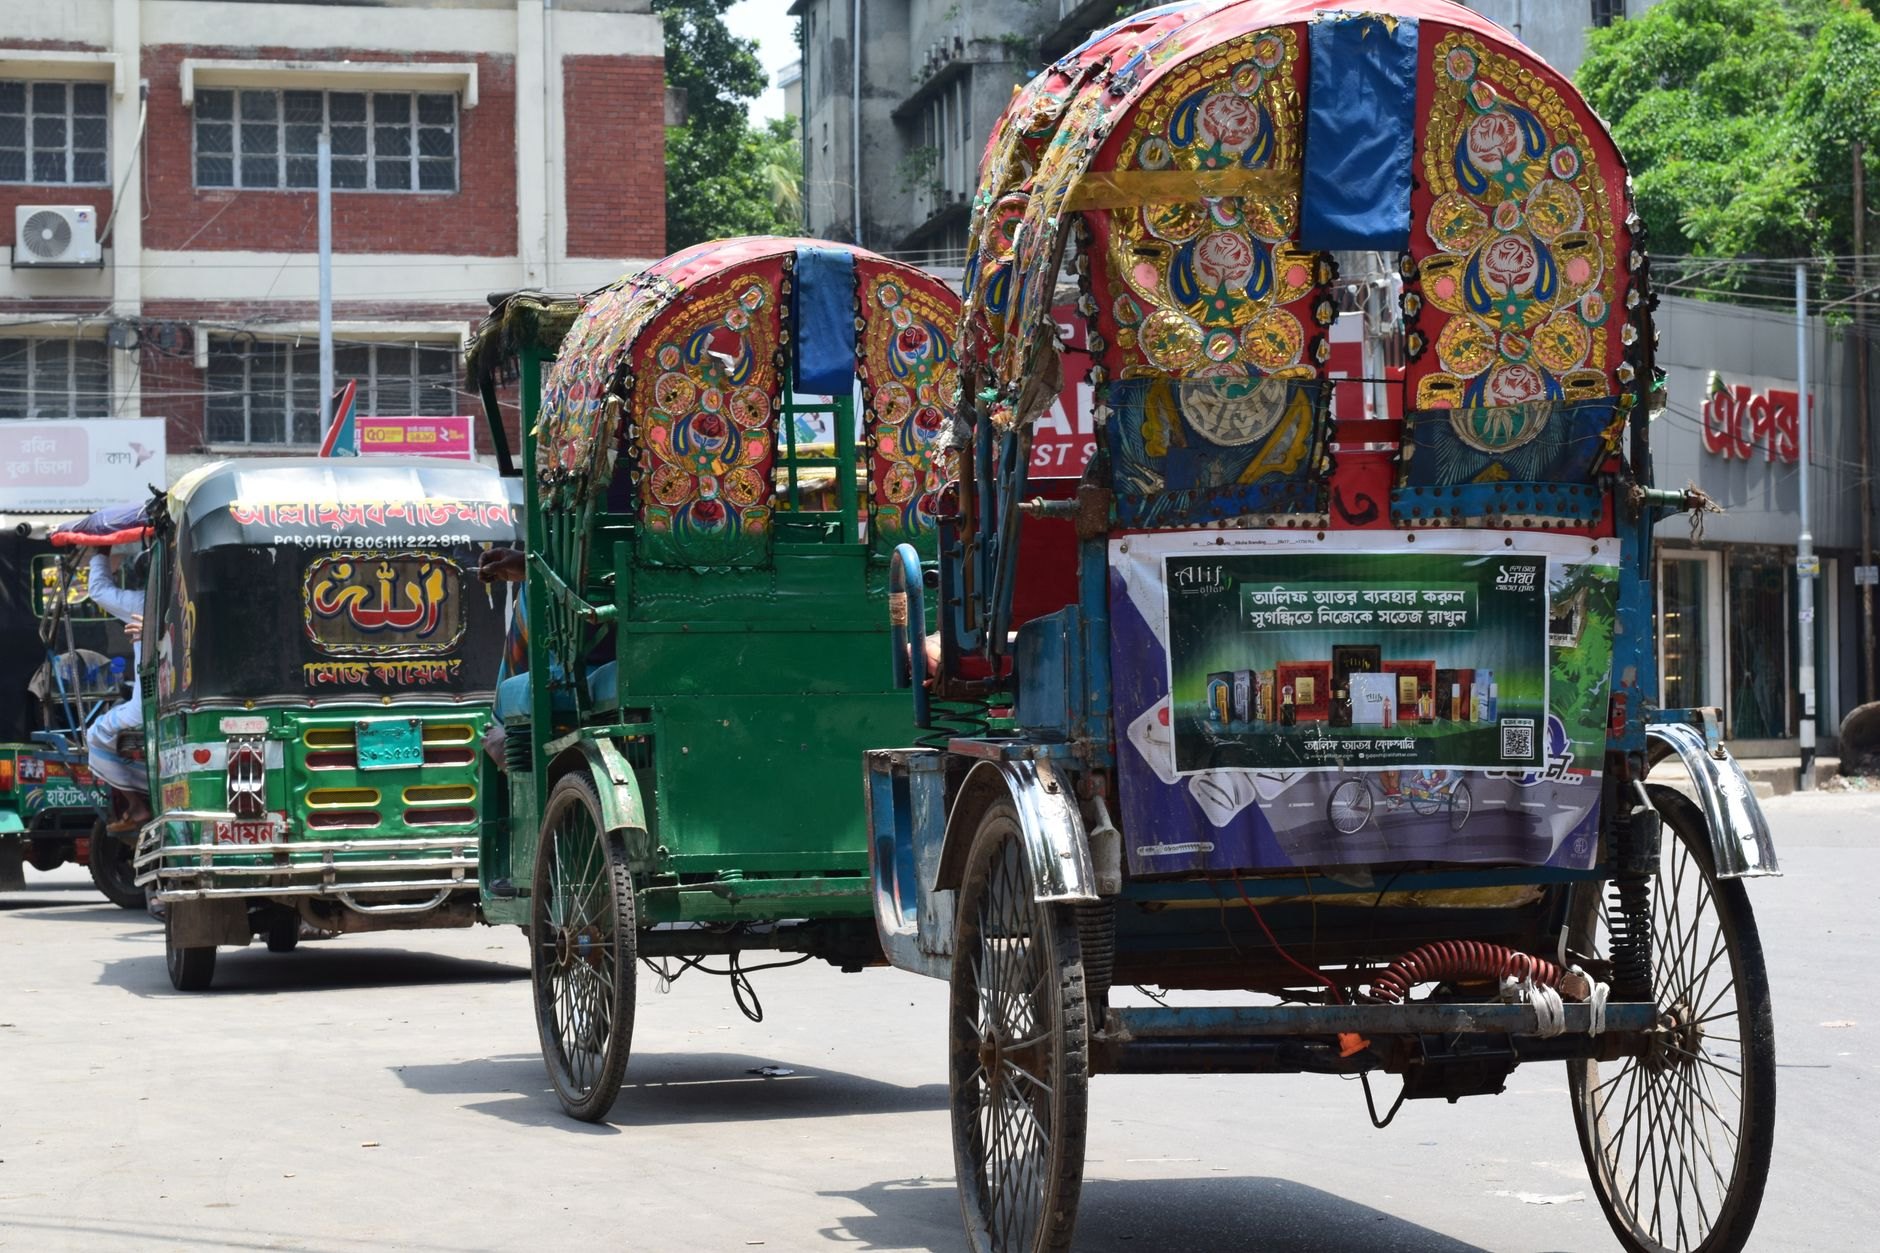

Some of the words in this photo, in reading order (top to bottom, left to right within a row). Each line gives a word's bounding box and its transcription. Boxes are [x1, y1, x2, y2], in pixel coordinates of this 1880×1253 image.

[1175, 566, 1222, 586] Alif
[1251, 586, 1308, 605] আলিফ
[1312, 591, 1358, 605] আতর
[1362, 591, 1418, 605] ব্যবহার
[1421, 591, 1465, 605] করুন
[1251, 606, 1314, 628] সুগন্ধিতে
[1317, 606, 1374, 625] নিজেকে
[1377, 611, 1424, 624] সতেজ
[1427, 611, 1467, 627] রাখুন
[1304, 738, 1339, 751] আলিফ
[1341, 741, 1371, 750] আতর
[1375, 737, 1415, 752] কোম্পানি
